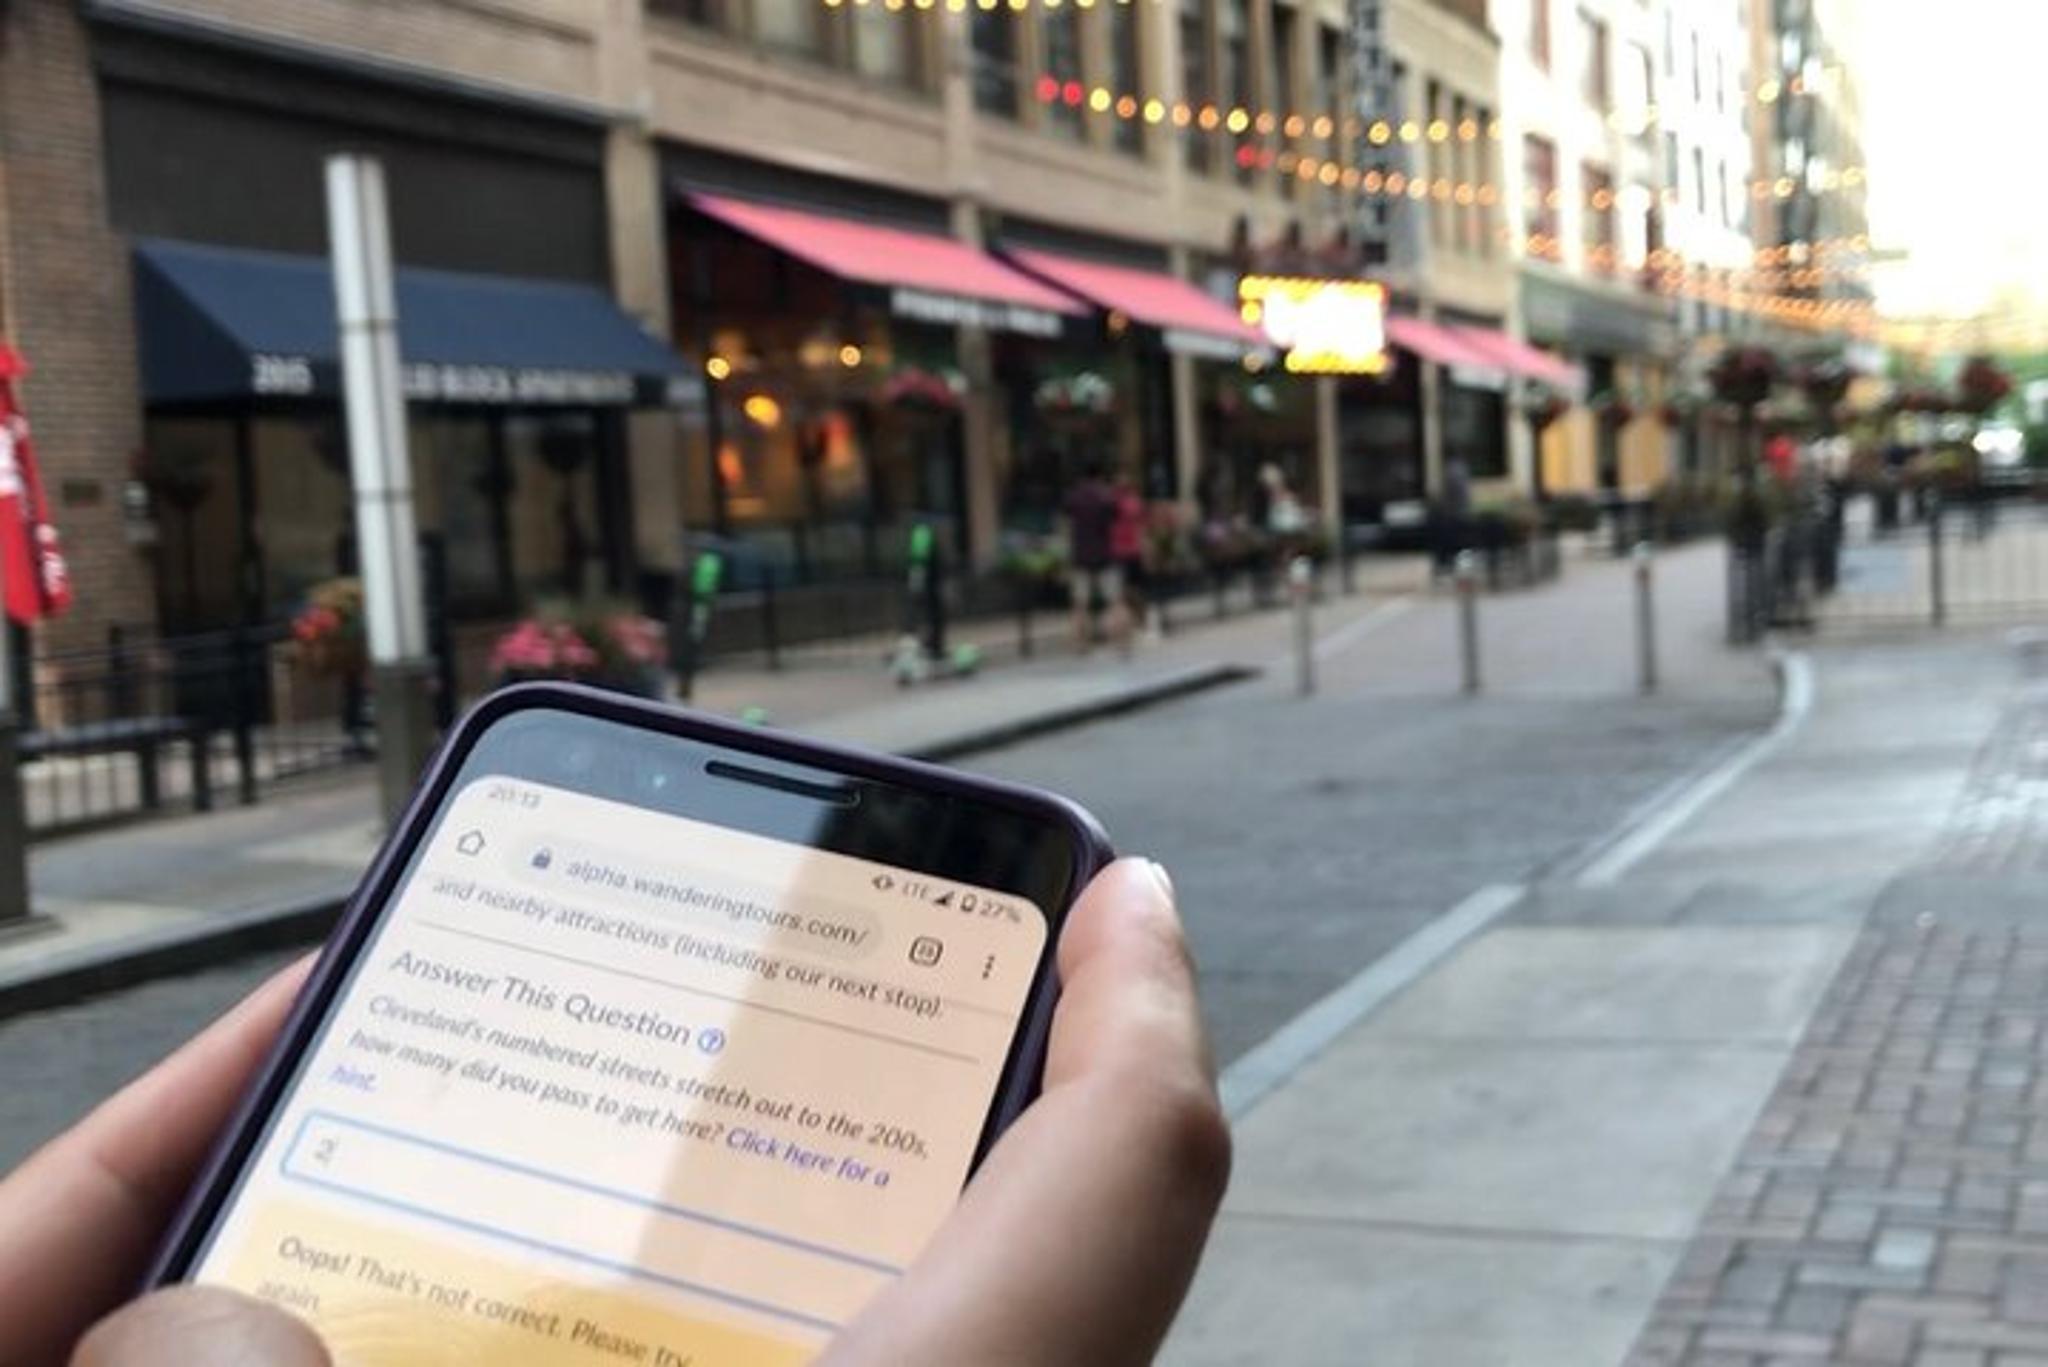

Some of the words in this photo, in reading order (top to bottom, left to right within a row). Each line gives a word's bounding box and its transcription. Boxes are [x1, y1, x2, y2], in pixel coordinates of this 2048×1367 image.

[432, 878, 476, 901] and
[477, 890, 552, 923] nearby
[554, 909, 670, 949] attractions
[674, 932, 781, 980] (including
[785, 965, 825, 986] our
[828, 971, 878, 1001] next
[567, 860, 869, 947] alpha.wanderingtours.com/
[980, 901, 1021, 923] 27%
[388, 951, 499, 995] Answer
[502, 975, 558, 1011] This
[564, 993, 691, 1046] Question
[368, 994, 484, 1041] Cleveland's
[486, 1029, 599, 1070] numbered
[599, 1055, 670, 1090] streets
[676, 1076, 751, 1111] stretch
[754, 1097, 794, 1122] out
[798, 1106, 822, 1129] to
[825, 1112, 864, 1139] the
[867, 1121, 930, 1160] 200s,
[395, 1043, 460, 1076] many
[460, 1057, 500, 1084] did
[497, 1070, 541, 1096] you
[539, 1082, 593, 1110] pass
[594, 1093, 620, 1116] to
[618, 1102, 660, 1127] get
[660, 1108, 725, 1143] here?
[726, 1125, 782, 1159] Click
[784, 1142, 836, 1173] here
[836, 1155, 872, 1183] for
[873, 1171, 891, 1188] a
[278, 1235, 353, 1275] Oops!
[356, 1255, 426, 1296] That's
[426, 1282, 472, 1309] not
[473, 1296, 562, 1339] correct.
[570, 1317, 650, 1362] Please
